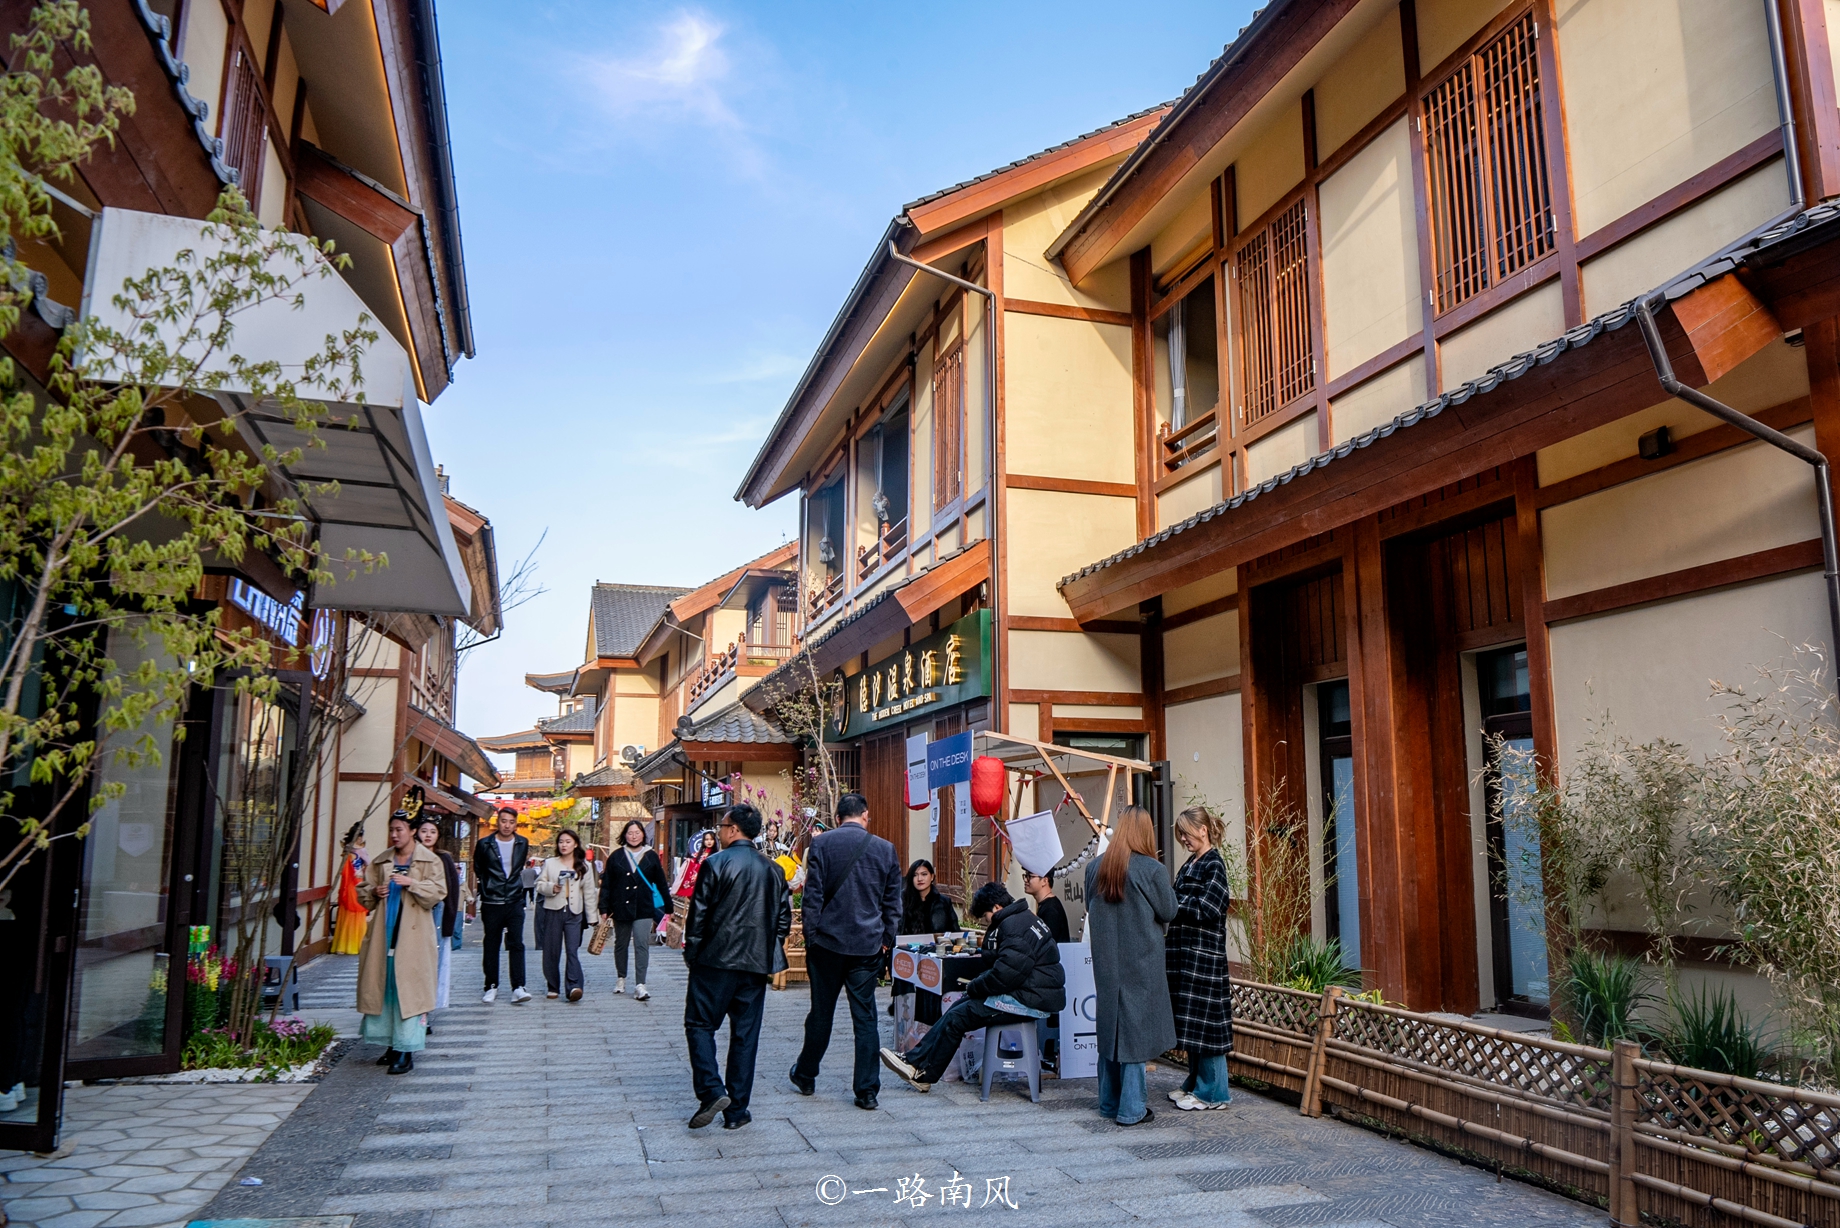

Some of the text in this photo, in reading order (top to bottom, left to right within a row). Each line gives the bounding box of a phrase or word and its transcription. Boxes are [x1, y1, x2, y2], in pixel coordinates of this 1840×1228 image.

[930, 751, 969, 771] ON THE DESK
